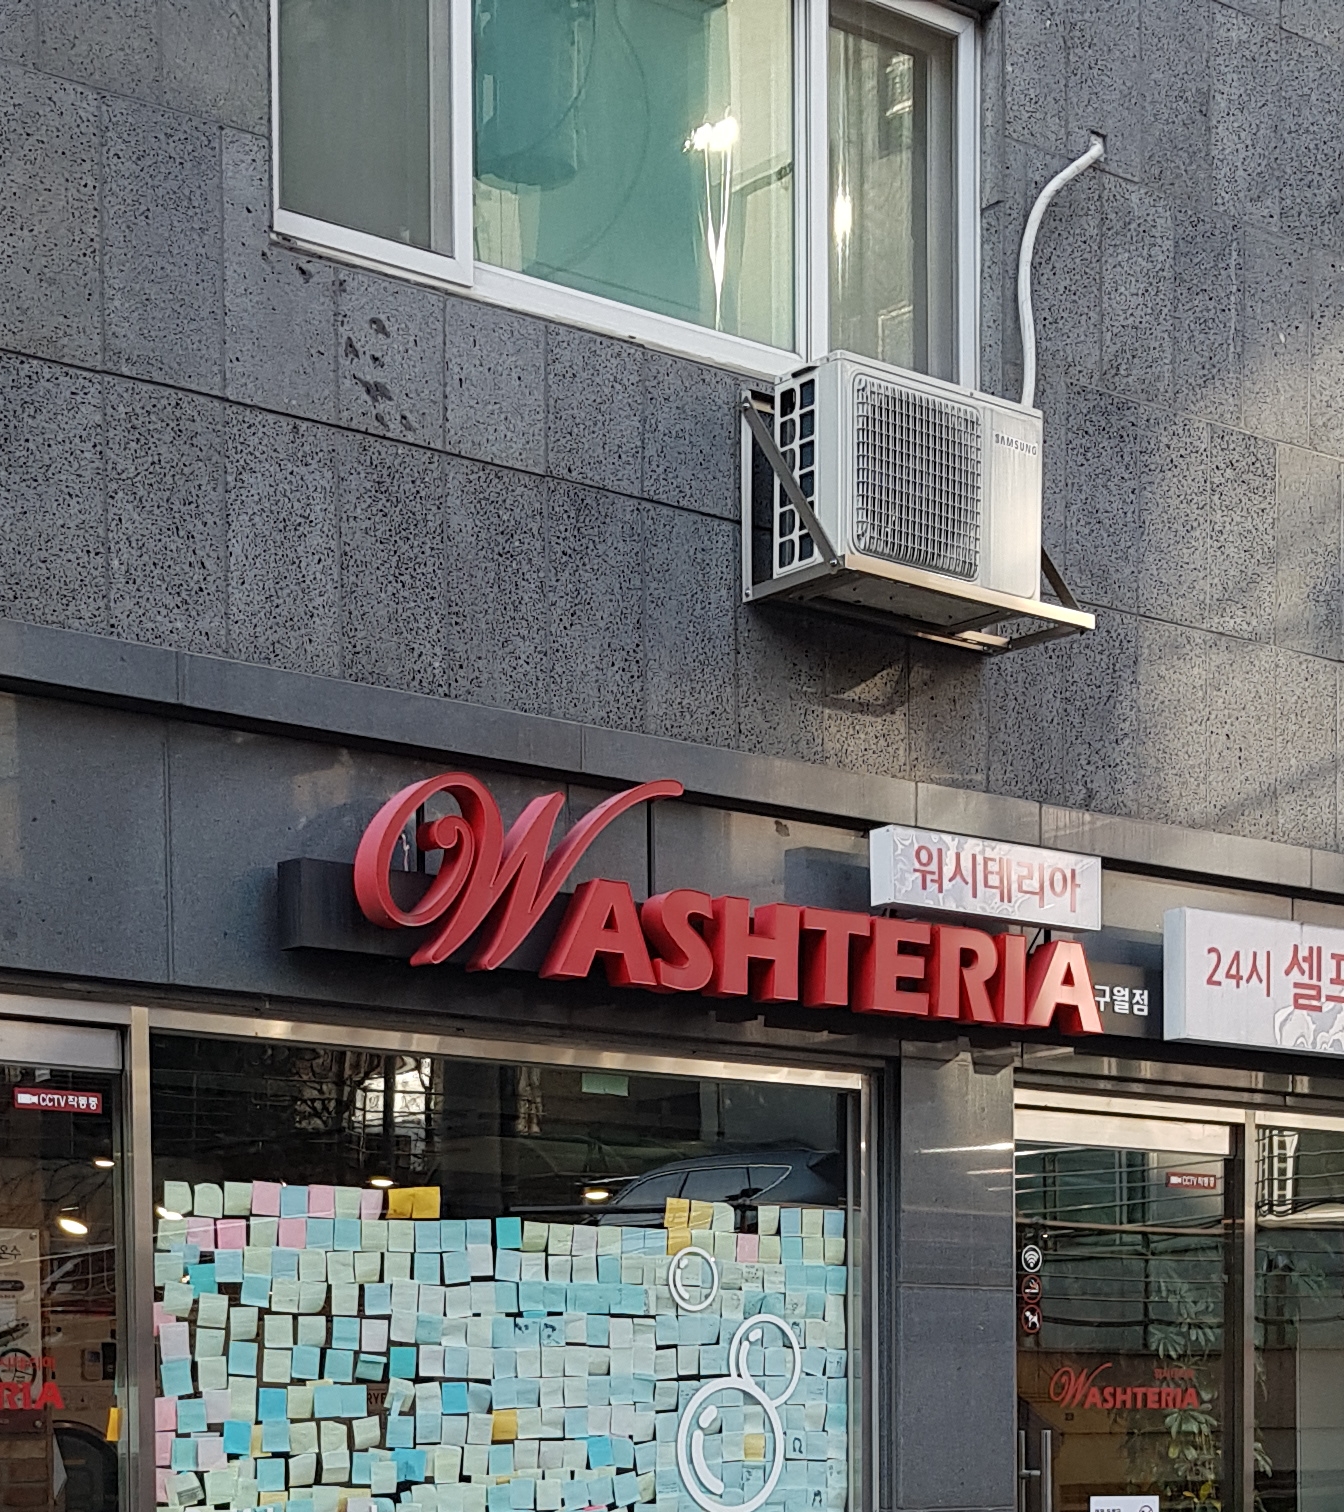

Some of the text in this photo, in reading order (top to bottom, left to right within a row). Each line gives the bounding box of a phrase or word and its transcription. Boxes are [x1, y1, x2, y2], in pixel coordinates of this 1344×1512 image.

[994, 432, 1038, 456] SAMSUNG
[912, 842, 1082, 914] 워시테리아
[1205, 945, 1272, 998] 24시
[1094, 984, 1149, 1018] 구월점
[1049, 1361, 1200, 1410] WASHTERIA
